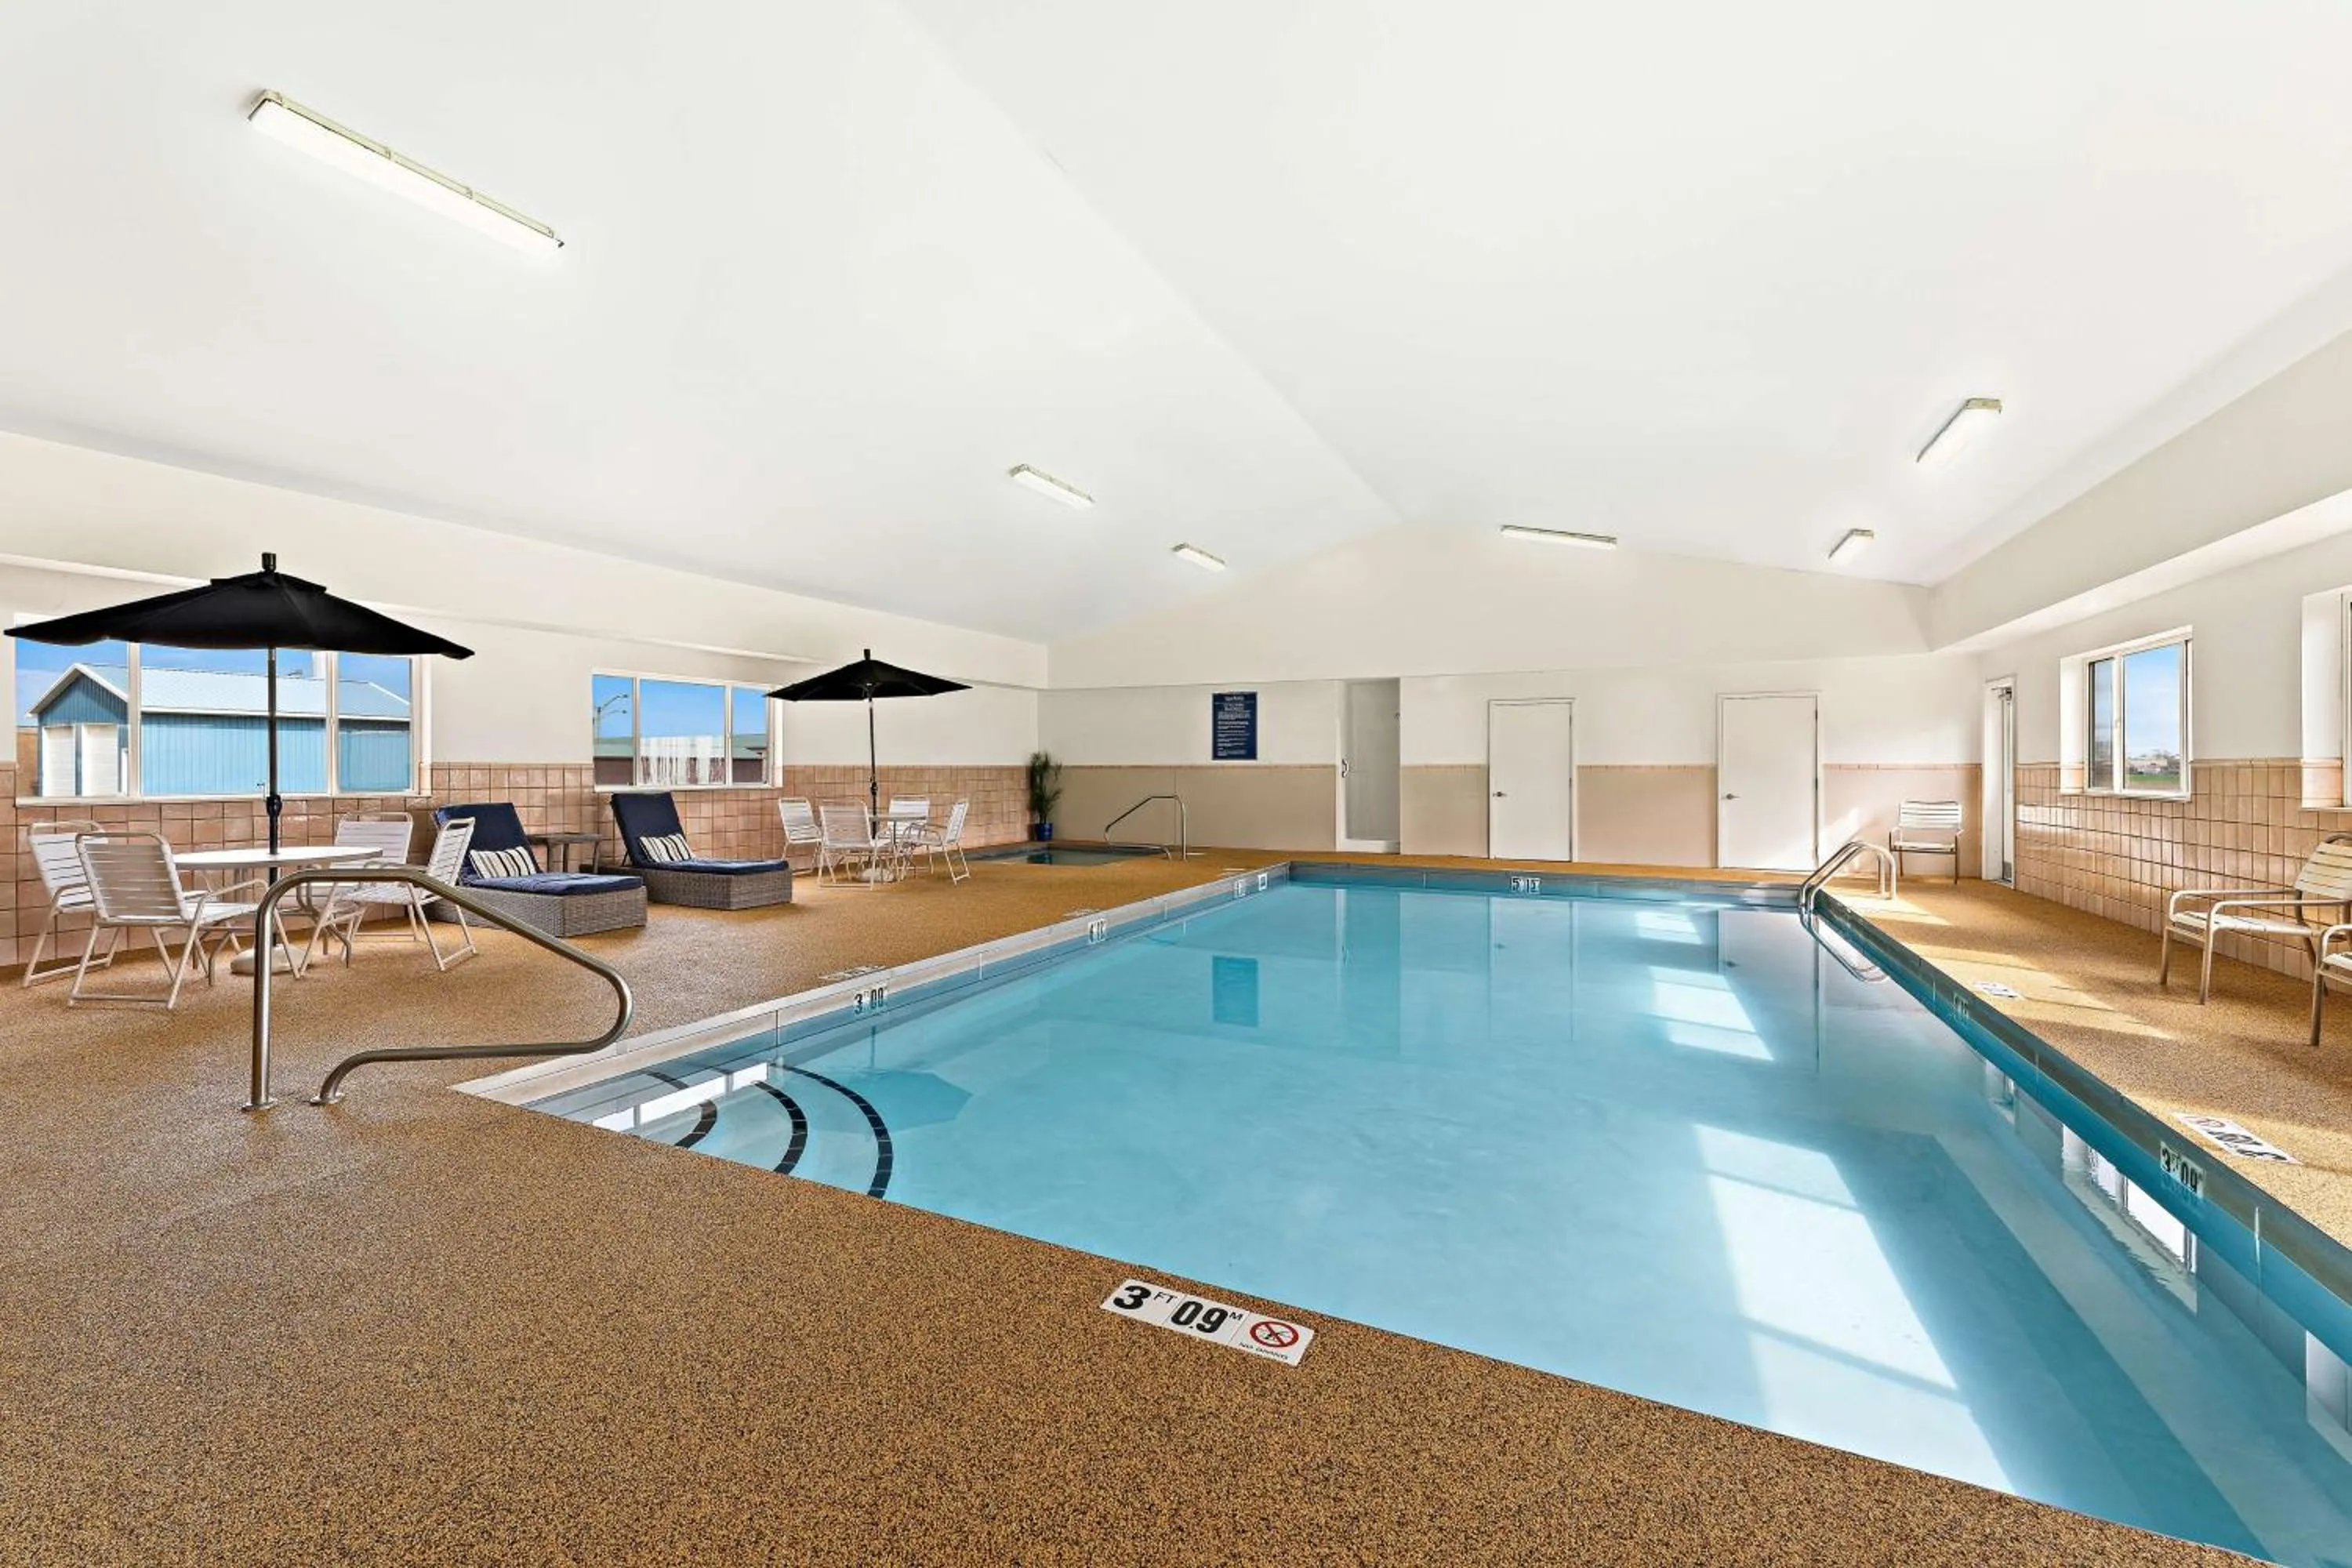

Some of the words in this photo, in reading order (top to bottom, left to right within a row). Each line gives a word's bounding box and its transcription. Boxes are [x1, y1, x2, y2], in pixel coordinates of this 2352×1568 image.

[1113, 1285, 1152, 1310] 3
[1153, 1291, 1178, 1304] FT
[1229, 1311, 1243, 1321] M
